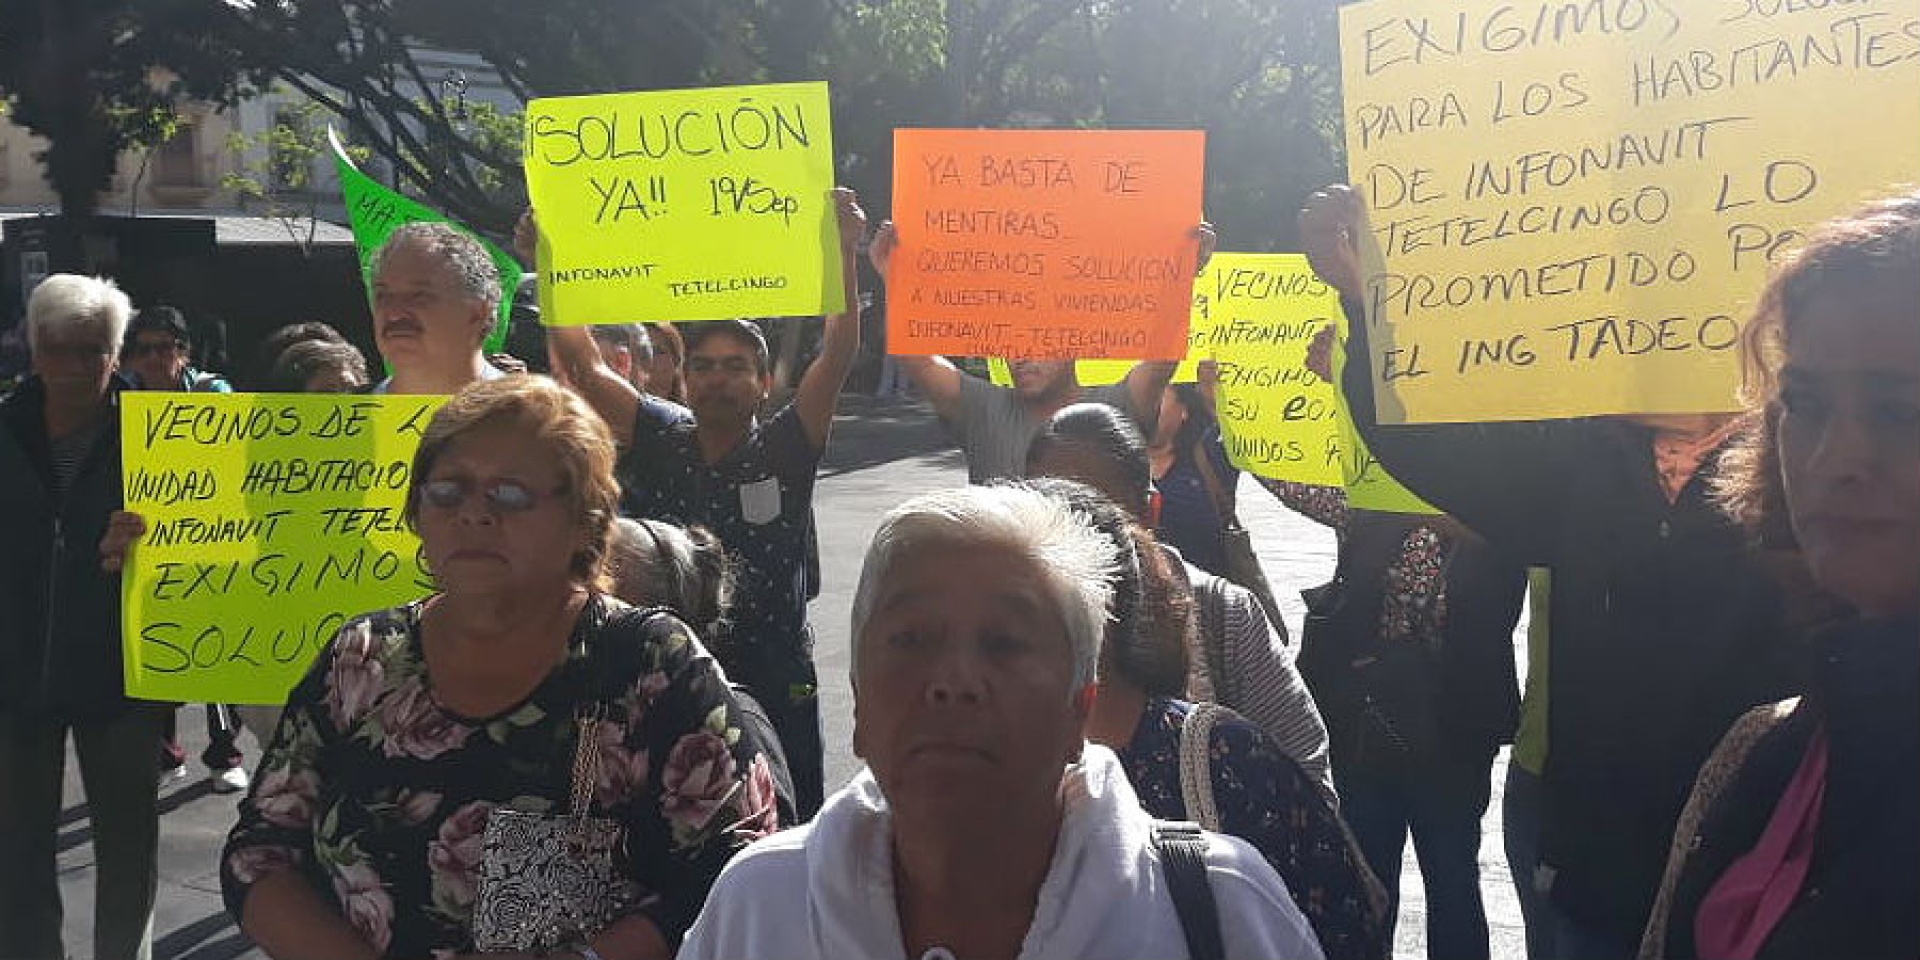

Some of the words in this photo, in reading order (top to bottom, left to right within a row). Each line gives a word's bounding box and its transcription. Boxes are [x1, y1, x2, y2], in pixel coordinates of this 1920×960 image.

[1356, 93, 1468, 150] PARA
[1493, 73, 1589, 125] LOS
[923, 155, 961, 186] YA
[980, 156, 1074, 190] BASTA
[1104, 161, 1145, 193] DE
[1368, 164, 1447, 211] DE
[1465, 117, 1753, 199] INFONAVIT
[589, 175, 668, 224] YA!!
[1374, 186, 1670, 258] TETELCINGO
[1714, 161, 1817, 213] LO
[549, 263, 658, 285] INFONAVIT
[917, 250, 1046, 277] QUEREMOS
[667, 276, 788, 298] TETELCINGO
[910, 290, 923, 304] A
[933, 288, 1036, 310] NUESTRAS
[1052, 294, 1159, 313] VIVIENDAS
[1217, 269, 1328, 303] VECINOS
[1368, 252, 1695, 328] PROMETIDO
[1382, 345, 1430, 384] EL
[1458, 334, 1537, 375] ING
[1545, 315, 1738, 361] TADEO
[145, 400, 301, 450] VECINOS
[311, 403, 383, 438] DE
[1226, 398, 1260, 421] SU
[127, 467, 217, 506] UNIDAD
[148, 511, 295, 547] INFONAVIT
